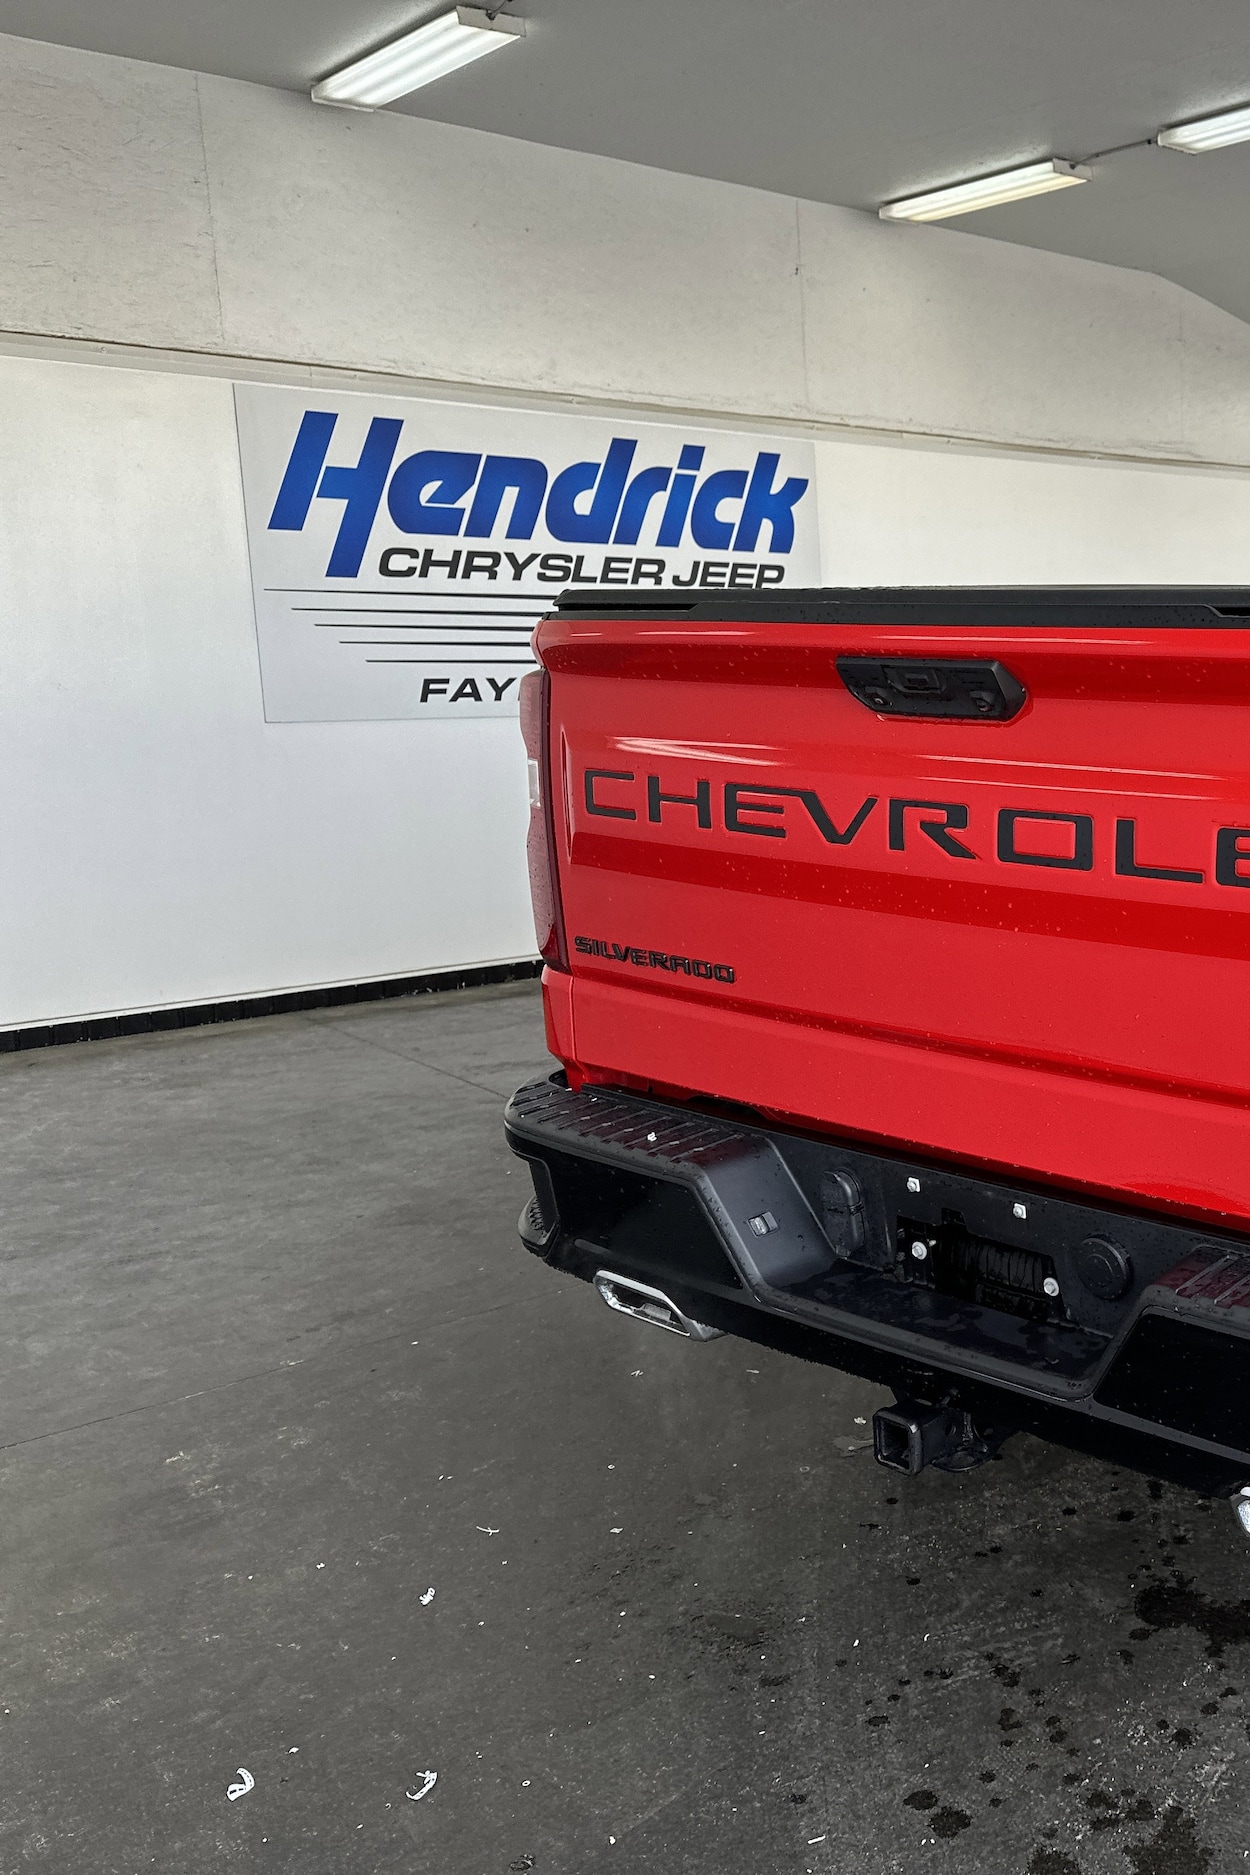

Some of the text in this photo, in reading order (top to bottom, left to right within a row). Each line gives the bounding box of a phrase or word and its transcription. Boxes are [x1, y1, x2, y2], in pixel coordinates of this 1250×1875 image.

[267, 410, 808, 577] Hendrick
[378, 547, 785, 589] CHRYSLER JEEP
[419, 677, 520, 703] FAY
[574, 935, 735, 984] SILVERADO
